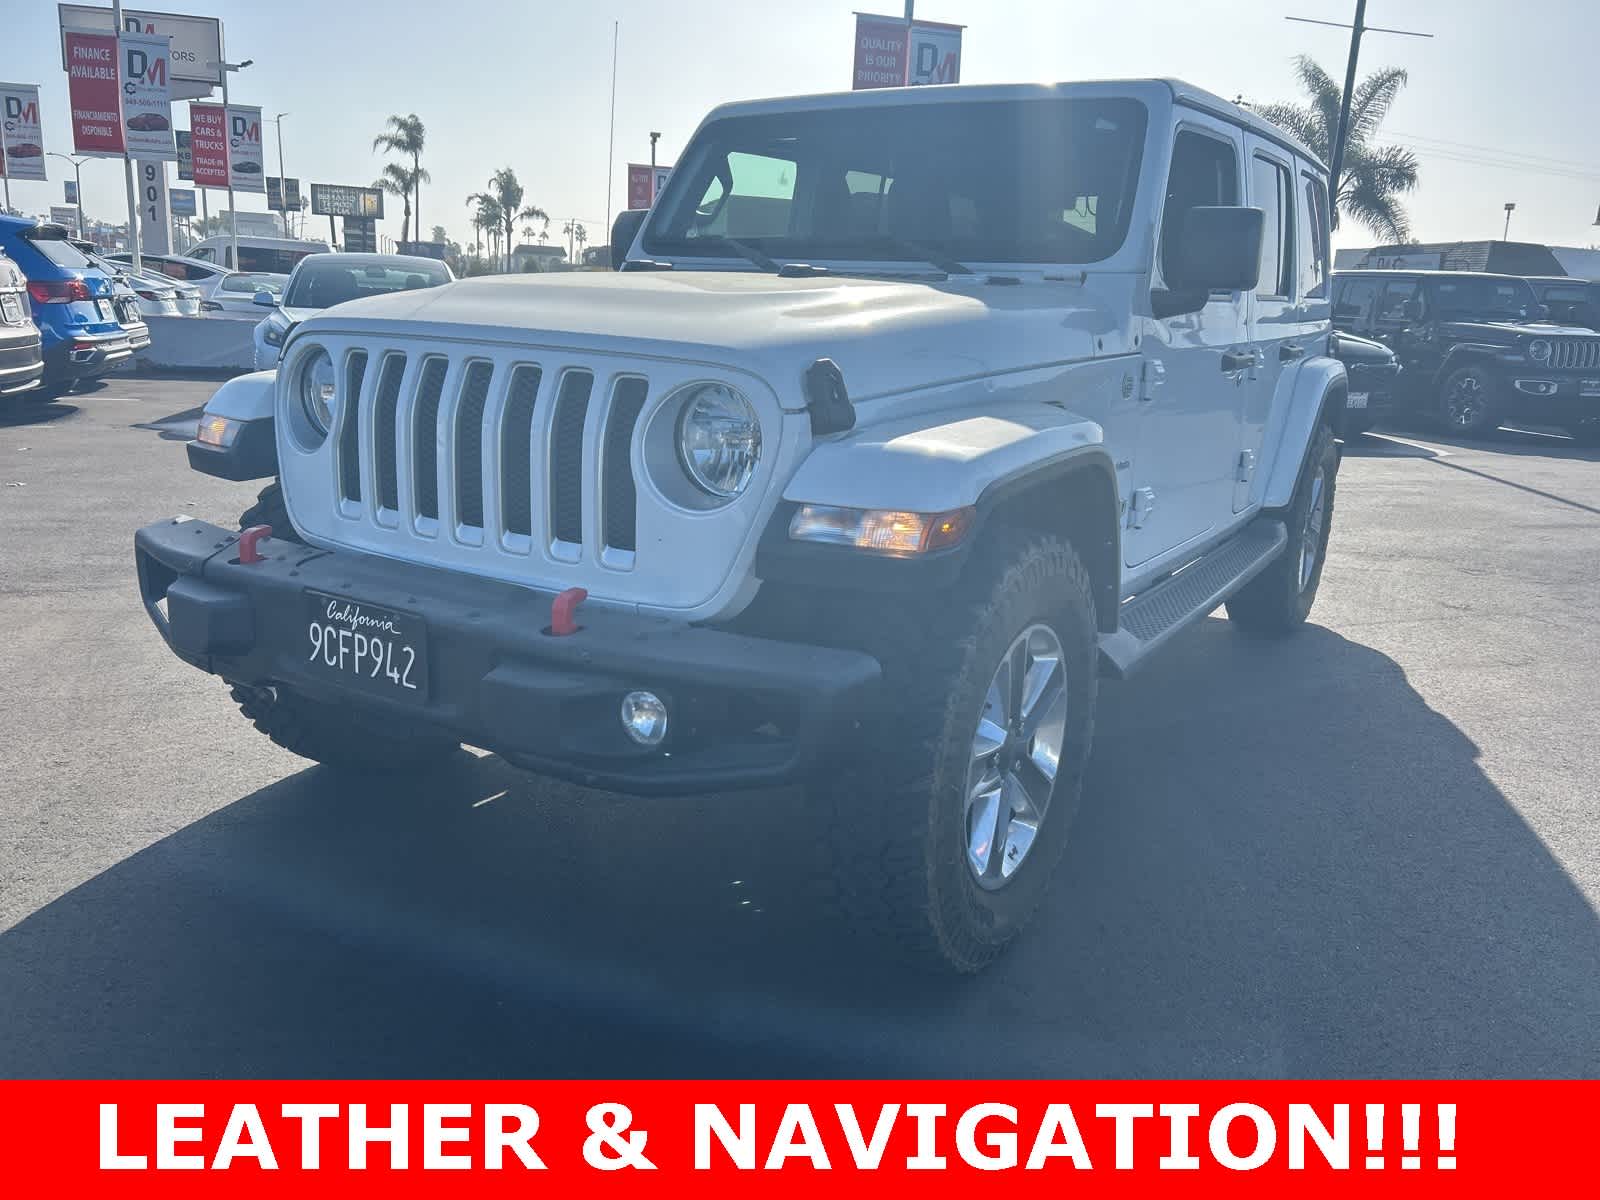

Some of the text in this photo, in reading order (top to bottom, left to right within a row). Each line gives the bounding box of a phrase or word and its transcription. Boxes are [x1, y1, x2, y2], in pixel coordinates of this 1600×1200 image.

[862, 38, 903, 52] QUALITY
[73, 46, 111, 61] FINANCE
[865, 54, 896, 68] IS OUR
[71, 65, 116, 80] AVAILABLE
[857, 70, 901, 83] PRIORITY
[194, 114, 222, 125] WE BUY
[81, 125, 113, 137] DISPONIBLE
[195, 126, 222, 137] CARS &
[195, 140, 225, 151] TRUCKS
[196, 157, 224, 167] TRADE-IN
[196, 167, 226, 177] ACCEPTED
[145, 164, 158, 222] 901
[327, 600, 402, 634] California
[309, 622, 417, 690] 9CFP942
